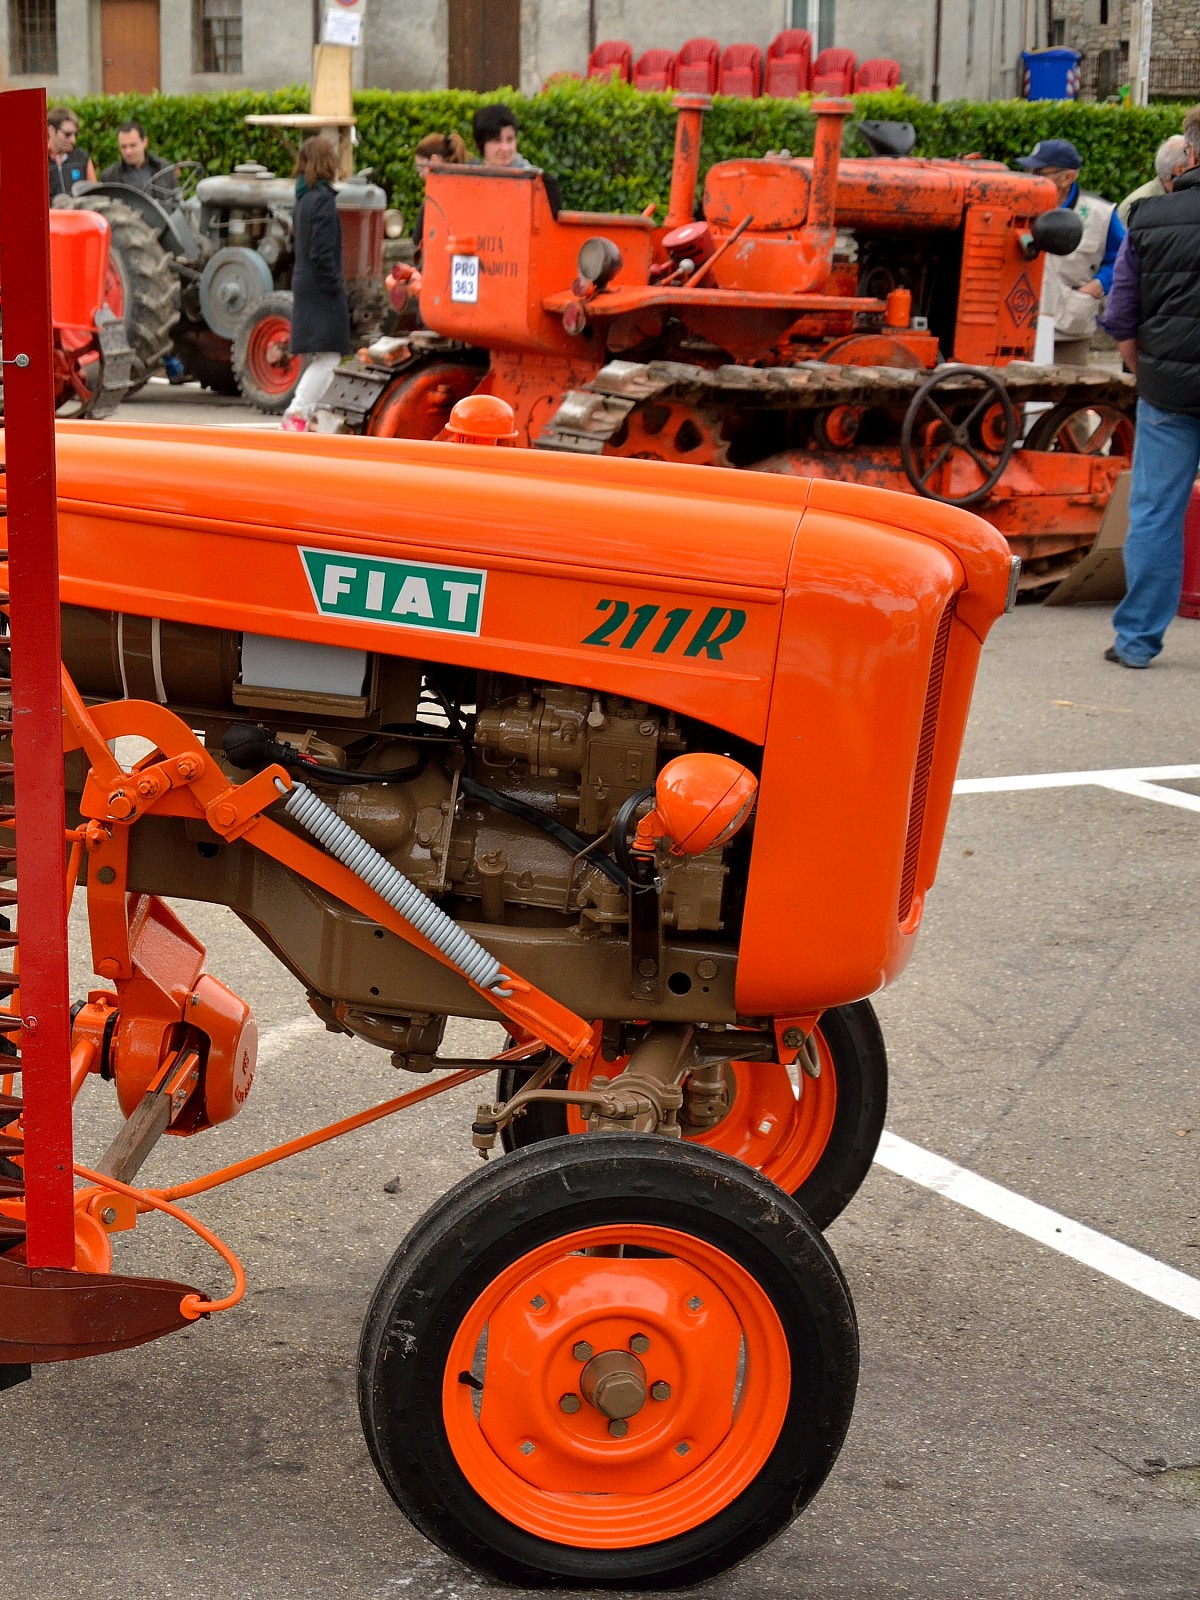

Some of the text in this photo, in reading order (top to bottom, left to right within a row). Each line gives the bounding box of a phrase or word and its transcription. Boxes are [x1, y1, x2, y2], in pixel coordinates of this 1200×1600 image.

[454, 262, 476, 277] PRO
[454, 279, 475, 295] 363
[321, 563, 479, 623] FIAT
[580, 598, 747, 661] 211R
